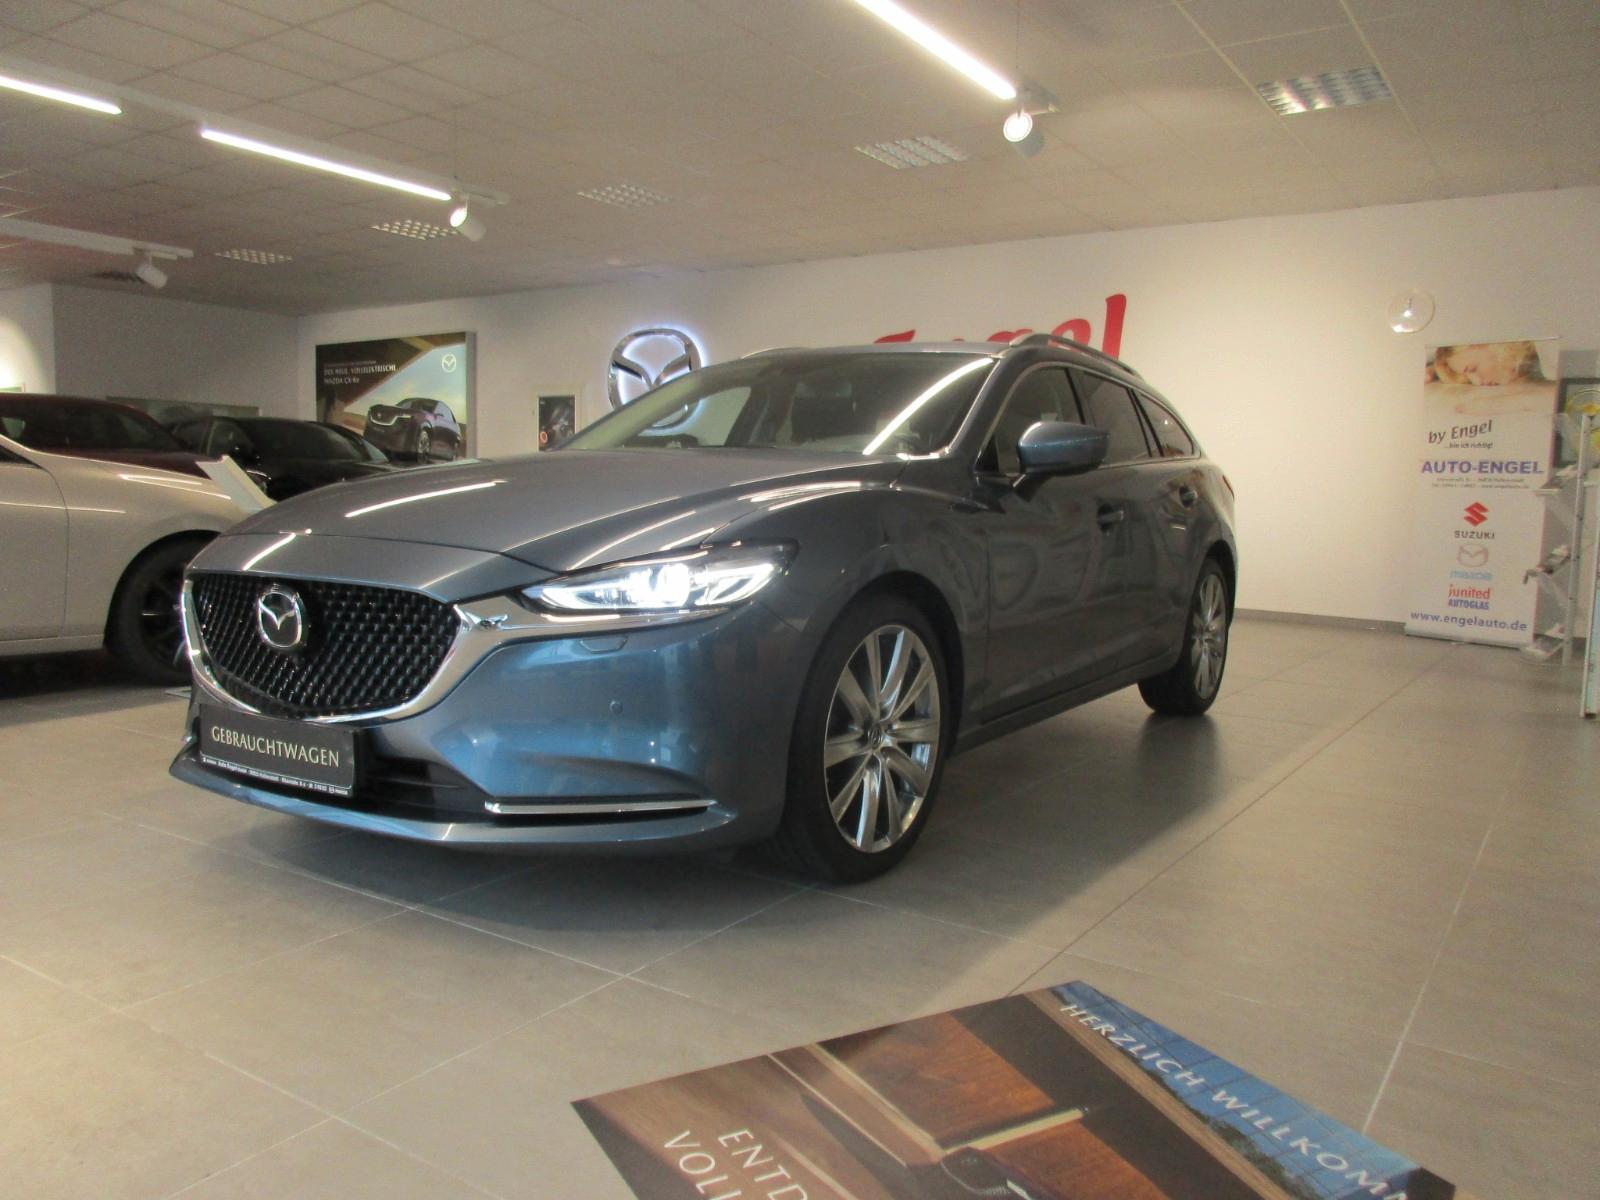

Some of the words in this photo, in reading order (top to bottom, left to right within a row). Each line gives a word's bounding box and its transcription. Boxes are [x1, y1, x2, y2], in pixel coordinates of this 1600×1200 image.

[1428, 430, 1446, 445] by
[1451, 419, 1493, 439] Engel
[1422, 461, 1544, 475] AUTO-ENGEL
[1454, 530, 1495, 540] SUZUKI
[1448, 584, 1491, 600] junited
[1448, 598, 1490, 610] AUTOGLAS
[1410, 611, 1528, 632] www.engelauto.de
[212, 726, 340, 768] GEBRAUCHTWAGEN
[1060, 1004, 1206, 1088] HERZLICH
